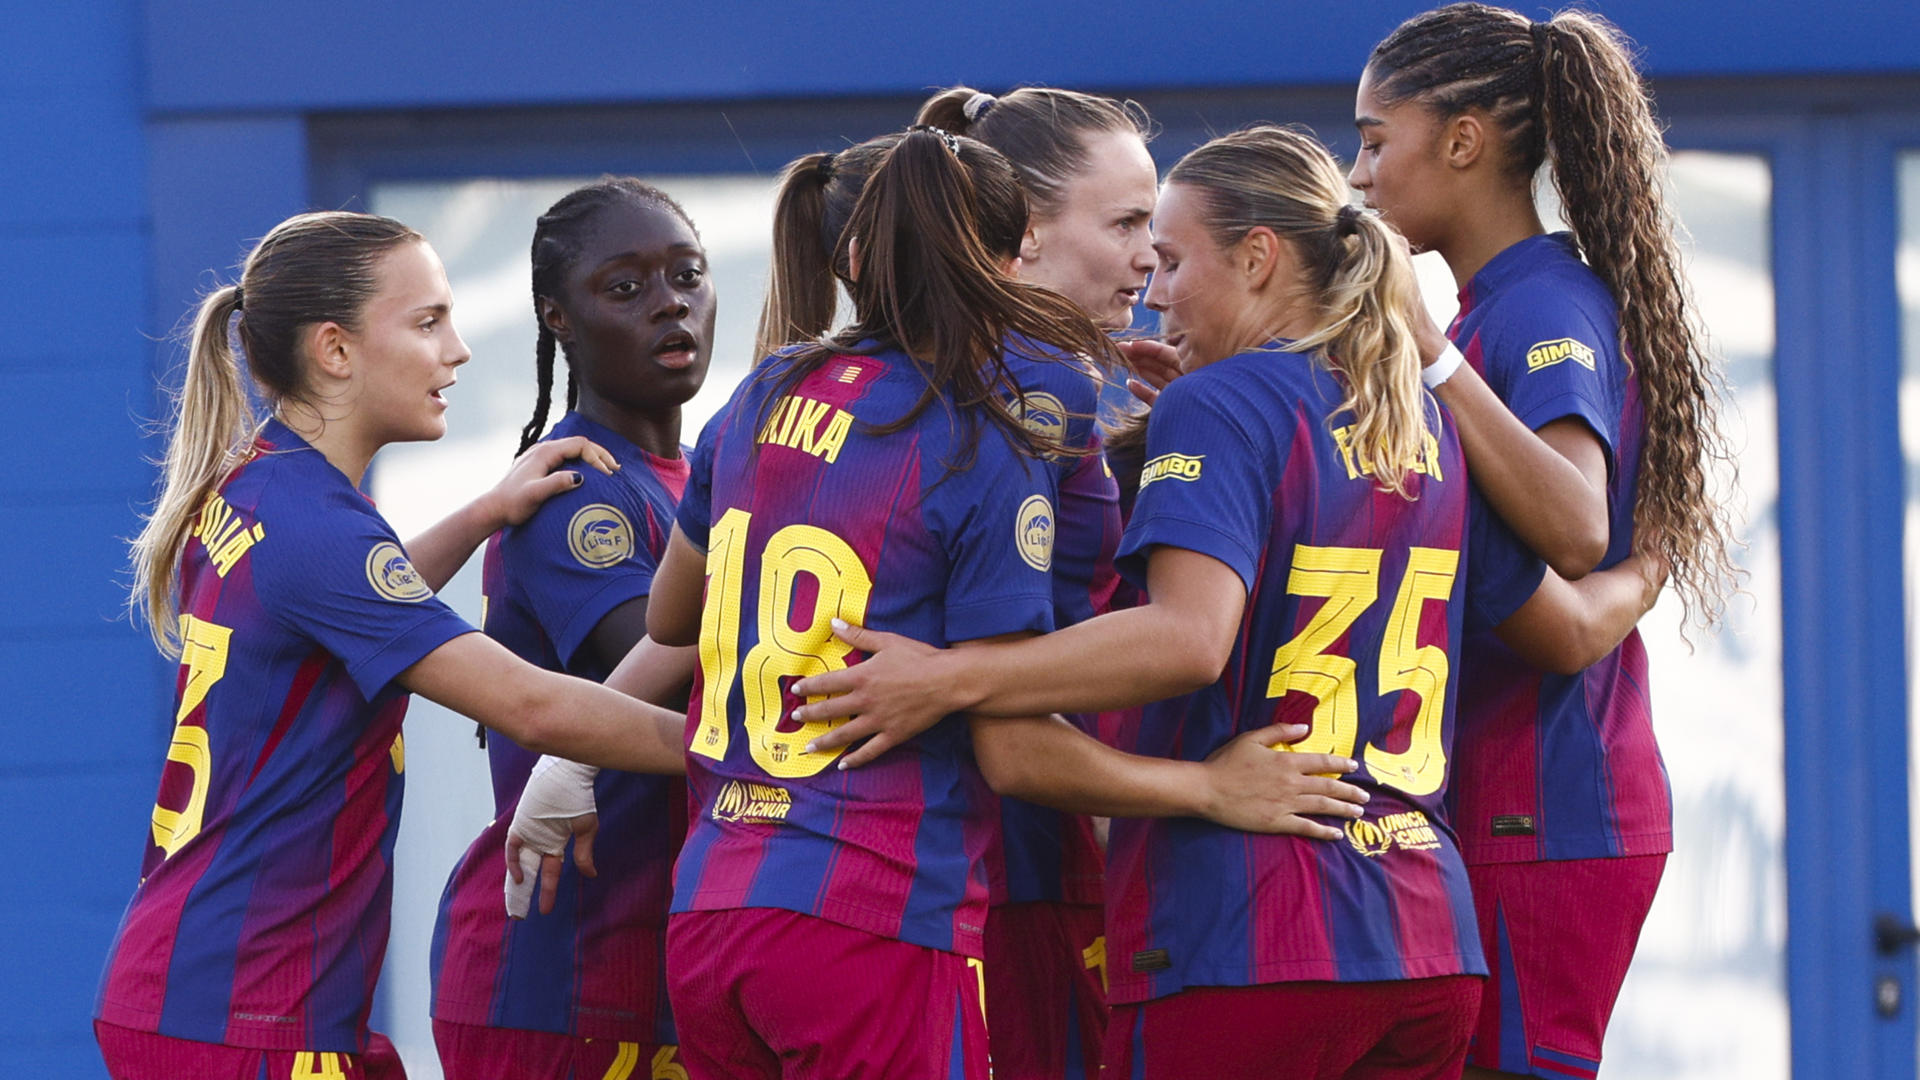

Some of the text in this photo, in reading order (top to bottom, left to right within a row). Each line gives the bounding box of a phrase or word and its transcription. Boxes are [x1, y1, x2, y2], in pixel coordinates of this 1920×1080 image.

[1527, 341, 1595, 369] BIMBO
[1140, 457, 1202, 487] BIMBO
[690, 507, 873, 778] 18
[1266, 543, 1460, 796] 35
[748, 783, 792, 803] UNHCR
[743, 801, 791, 819] ACNUR
[1378, 810, 1429, 834] UNHCR
